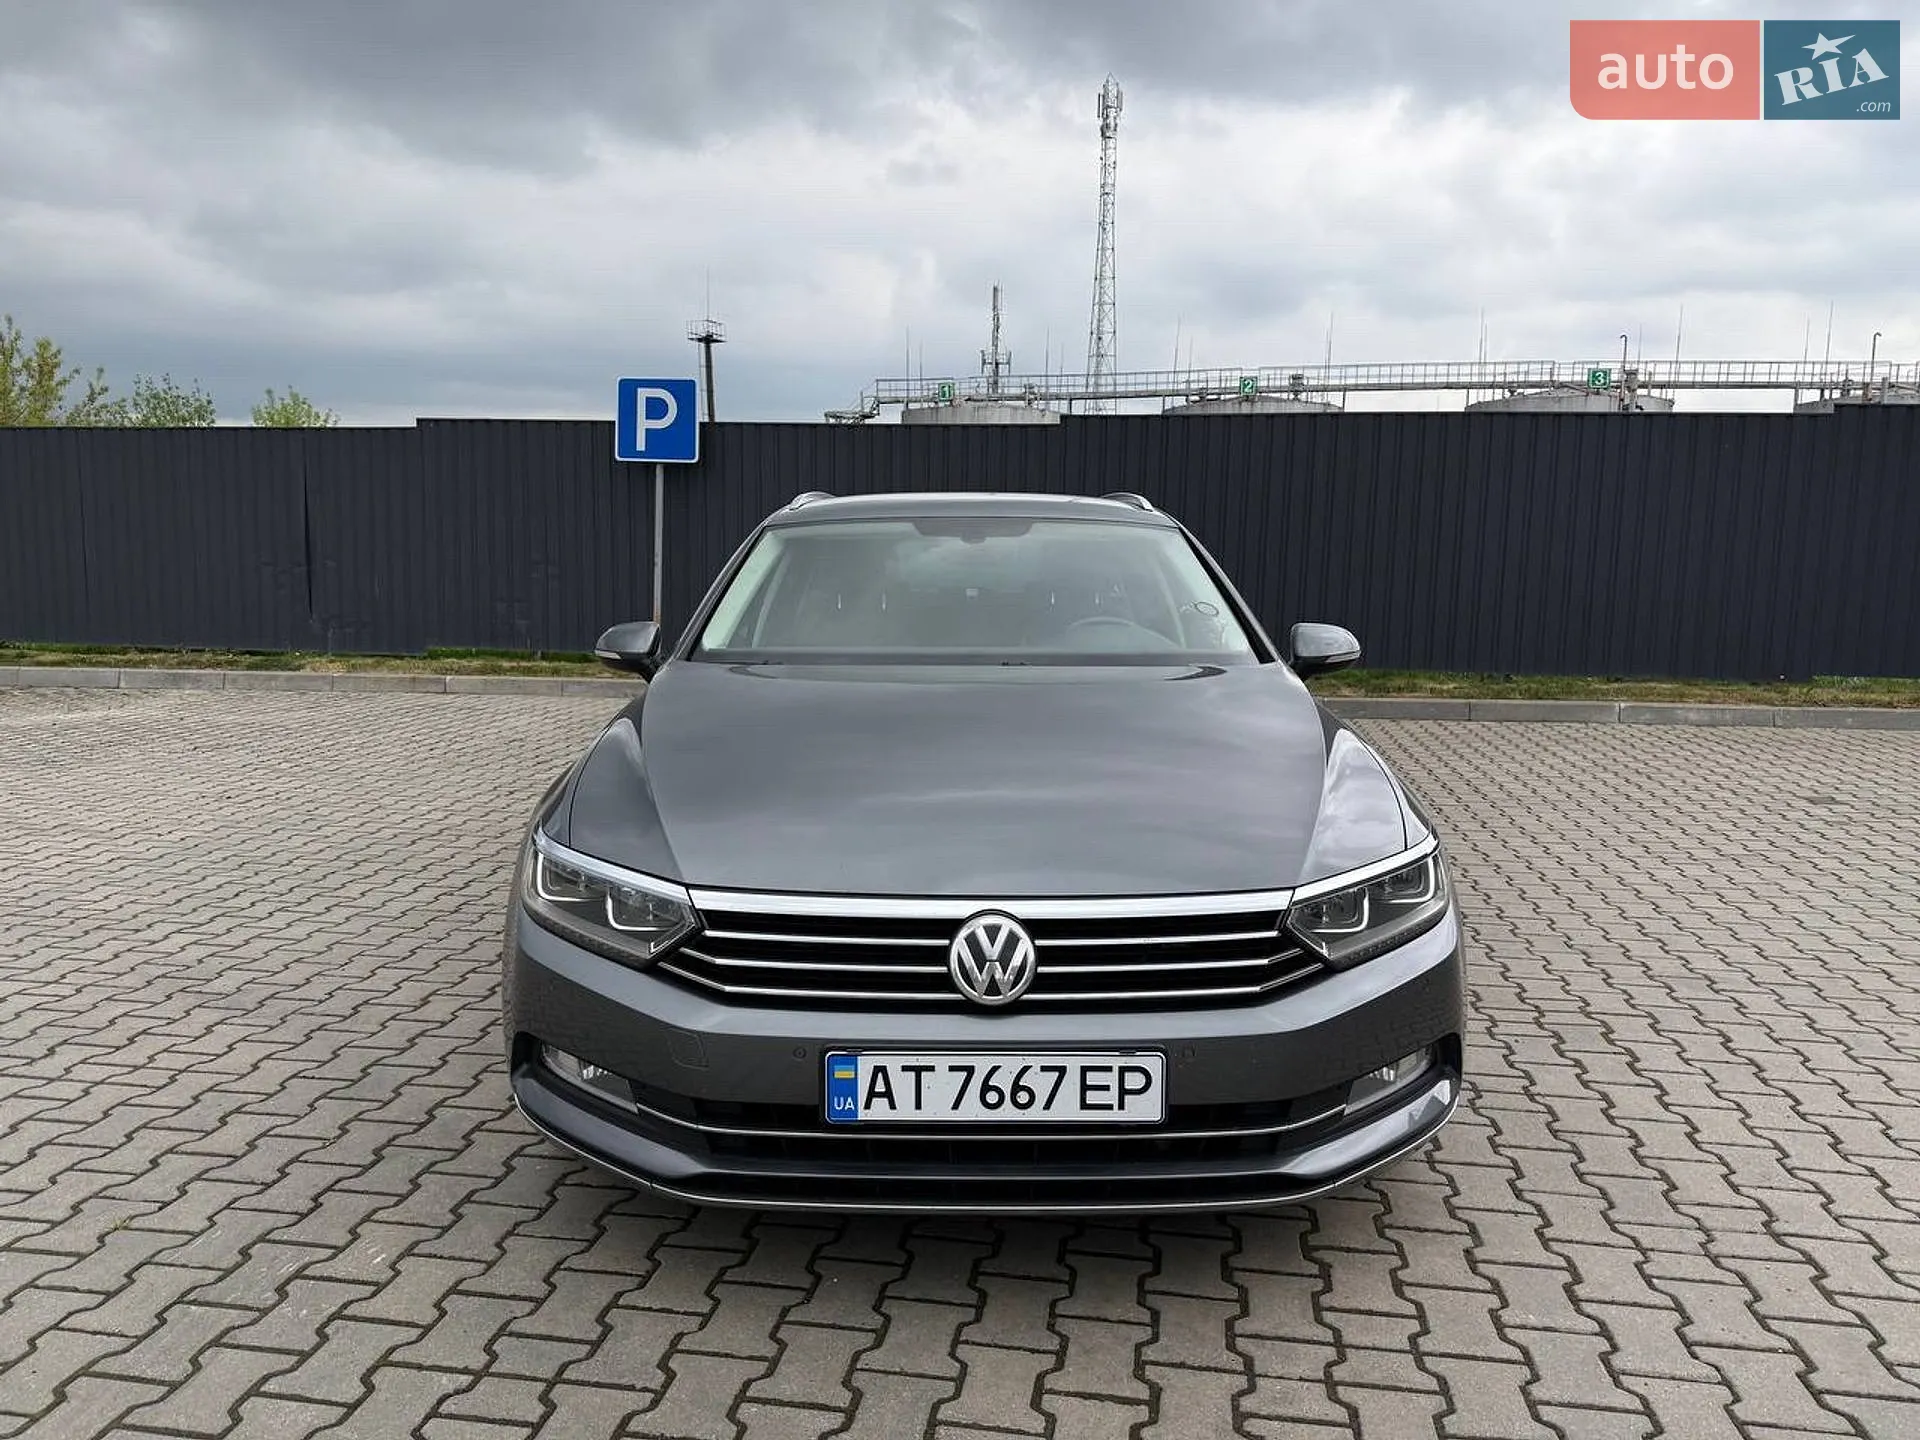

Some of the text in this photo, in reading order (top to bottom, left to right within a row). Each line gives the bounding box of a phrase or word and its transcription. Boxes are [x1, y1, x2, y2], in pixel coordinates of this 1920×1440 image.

[636, 387, 678, 452] P
[834, 1096, 855, 1111] UA
[863, 1064, 1153, 1111] AT 7667 EP
